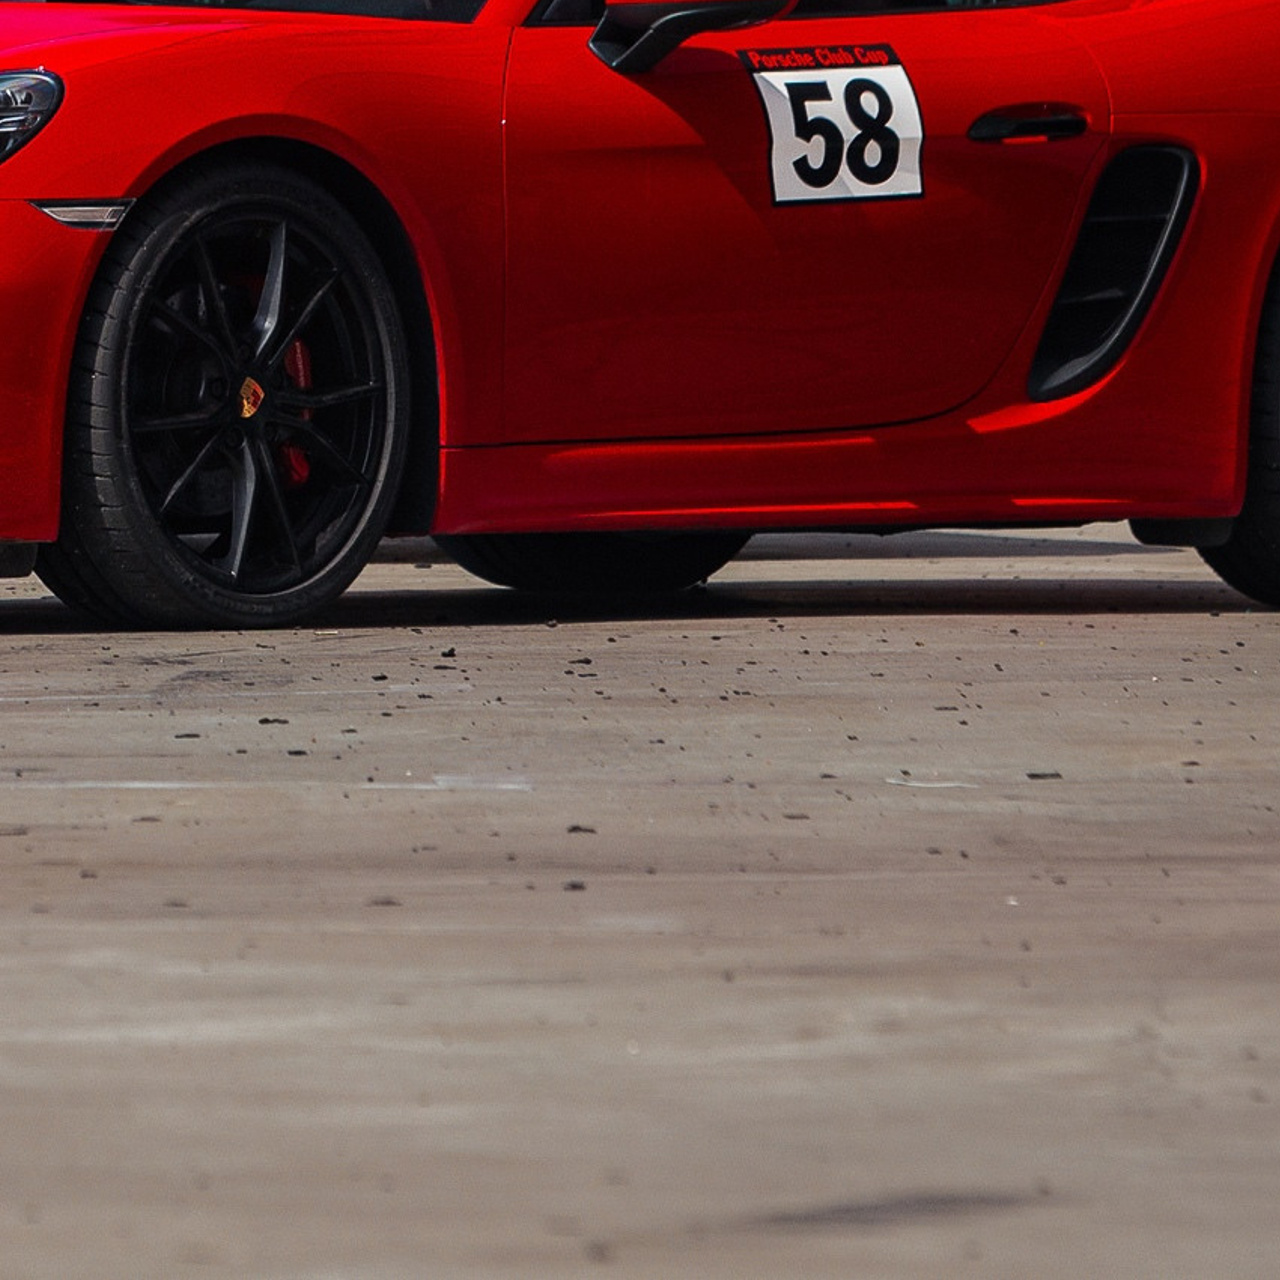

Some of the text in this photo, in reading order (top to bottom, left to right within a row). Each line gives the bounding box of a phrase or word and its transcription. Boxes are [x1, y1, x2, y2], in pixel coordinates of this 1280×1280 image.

[749, 48, 888, 68] Porsche Club Cup
[784, 77, 901, 189] 58
